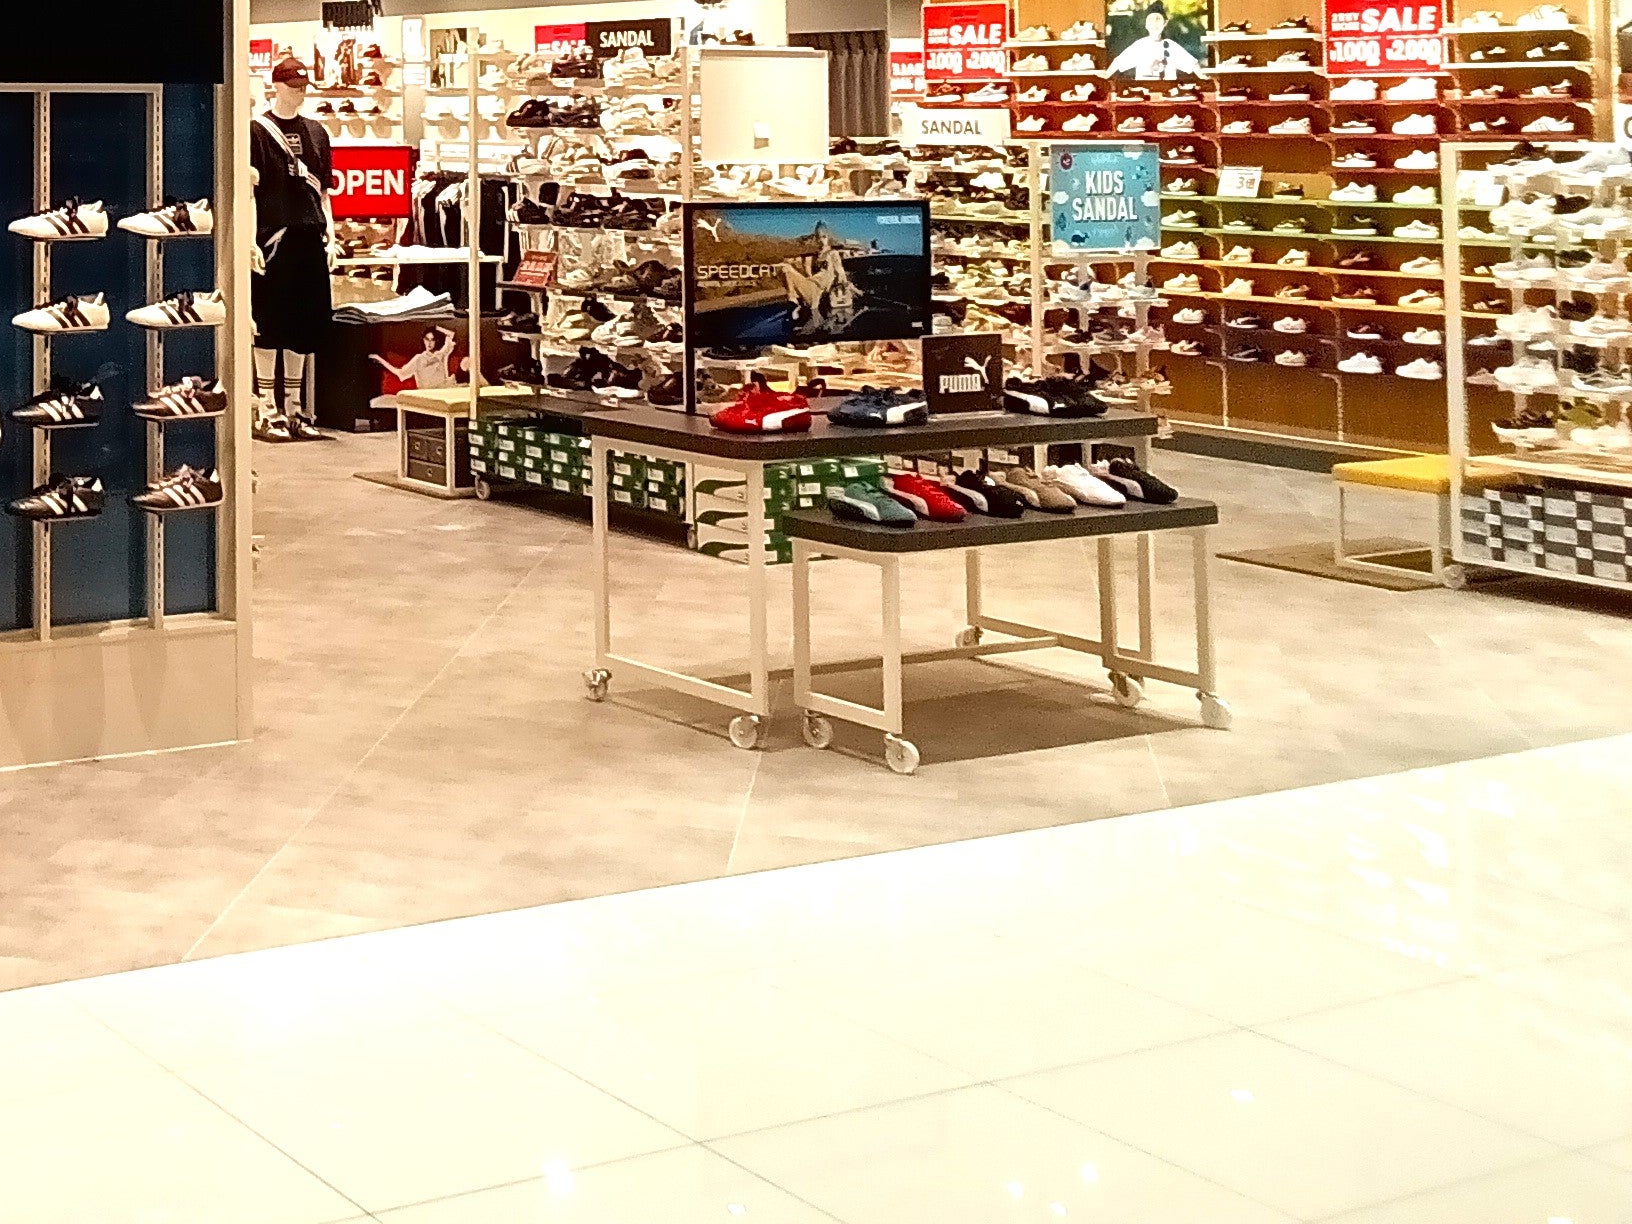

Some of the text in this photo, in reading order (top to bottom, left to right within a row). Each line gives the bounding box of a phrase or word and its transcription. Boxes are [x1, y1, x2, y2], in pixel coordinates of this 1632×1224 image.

[1360, 6, 1437, 33] SALE
[599, 29, 655, 48] SANDAL
[948, 23, 1002, 46] SALE
[920, 118, 982, 136] SANDAL
[329, 168, 405, 196] OPEN
[1084, 170, 1125, 195] KIDS
[1072, 196, 1138, 222] SANDAL
[696, 263, 778, 280] SPEEDCAT
[939, 373, 985, 394] PUMA
